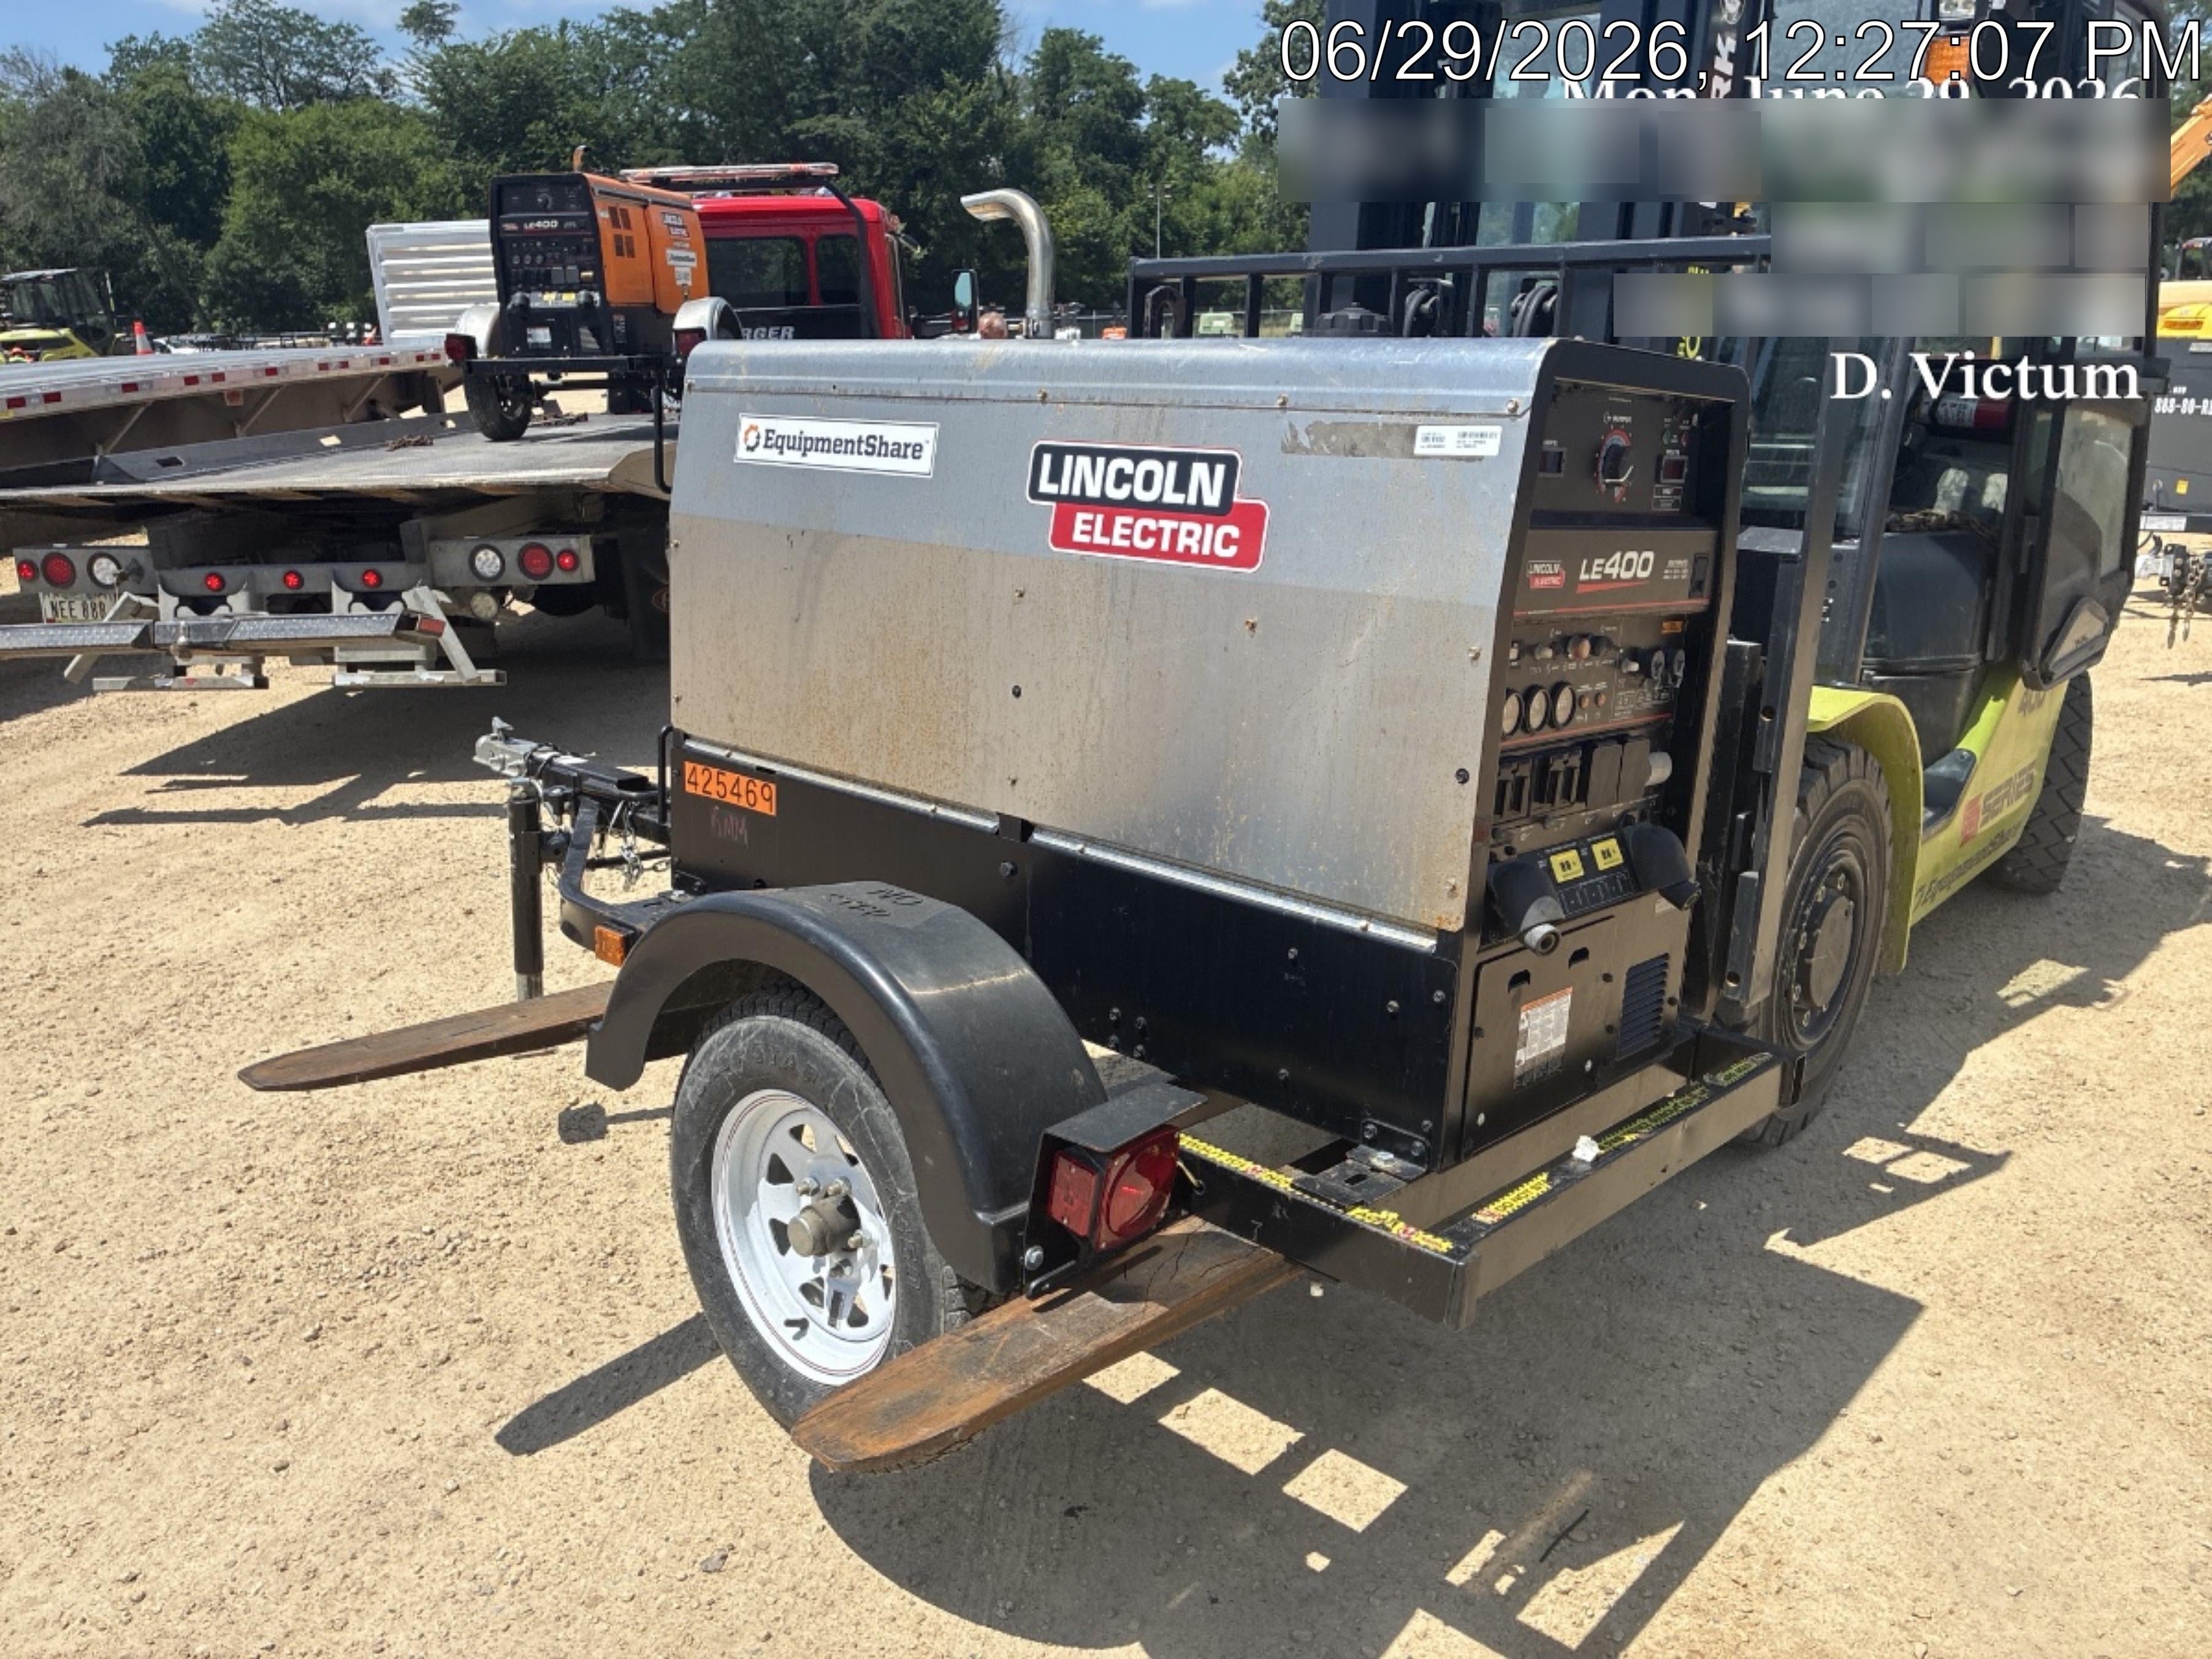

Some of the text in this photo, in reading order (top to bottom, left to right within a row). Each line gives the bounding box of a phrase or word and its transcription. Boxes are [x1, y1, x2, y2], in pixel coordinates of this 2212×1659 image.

[741, 325, 795, 340] RGER
[763, 428, 925, 461] EquipmentShare
[1038, 452, 1226, 507] LINCOLN
[1072, 512, 1240, 558] ELECTRIC
[1580, 551, 1655, 581] LE400
[686, 766, 774, 813] 425469
